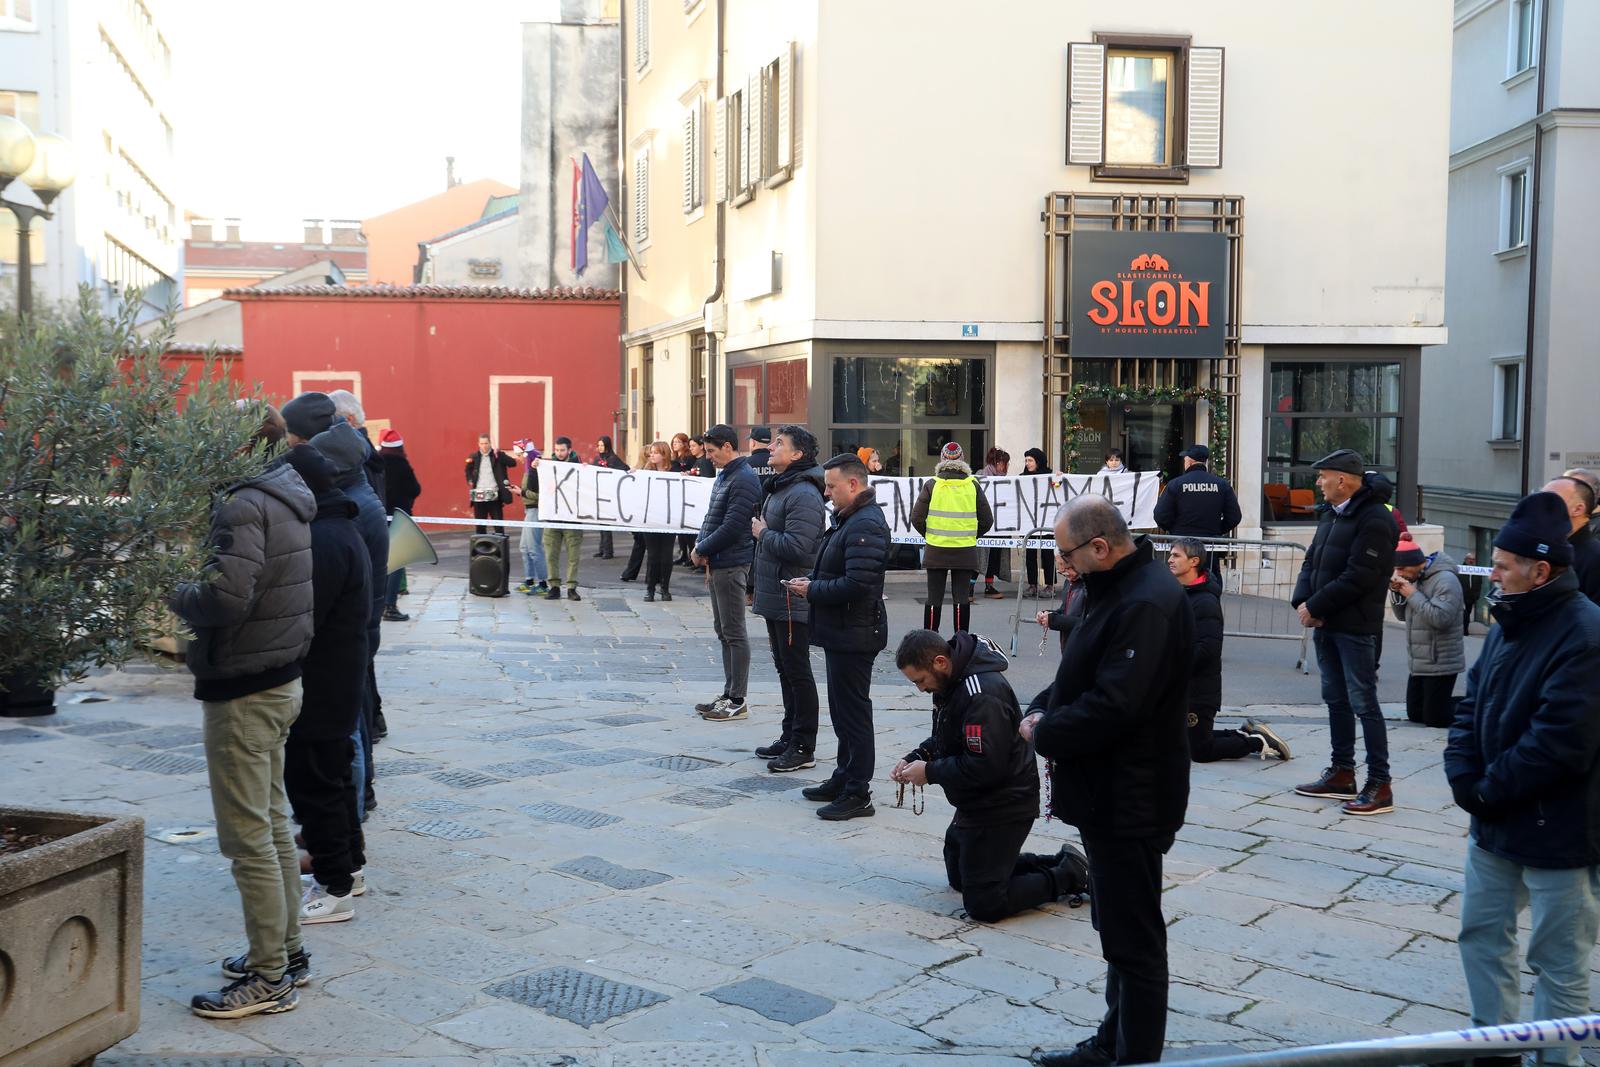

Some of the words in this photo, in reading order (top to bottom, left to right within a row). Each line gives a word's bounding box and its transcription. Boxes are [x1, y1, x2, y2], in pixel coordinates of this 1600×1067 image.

[1087, 280, 1211, 327] SLON
[1077, 432, 1101, 442] SLON
[1182, 483, 1219, 493] POLICIJA
[307, 903, 323, 911] FILA
